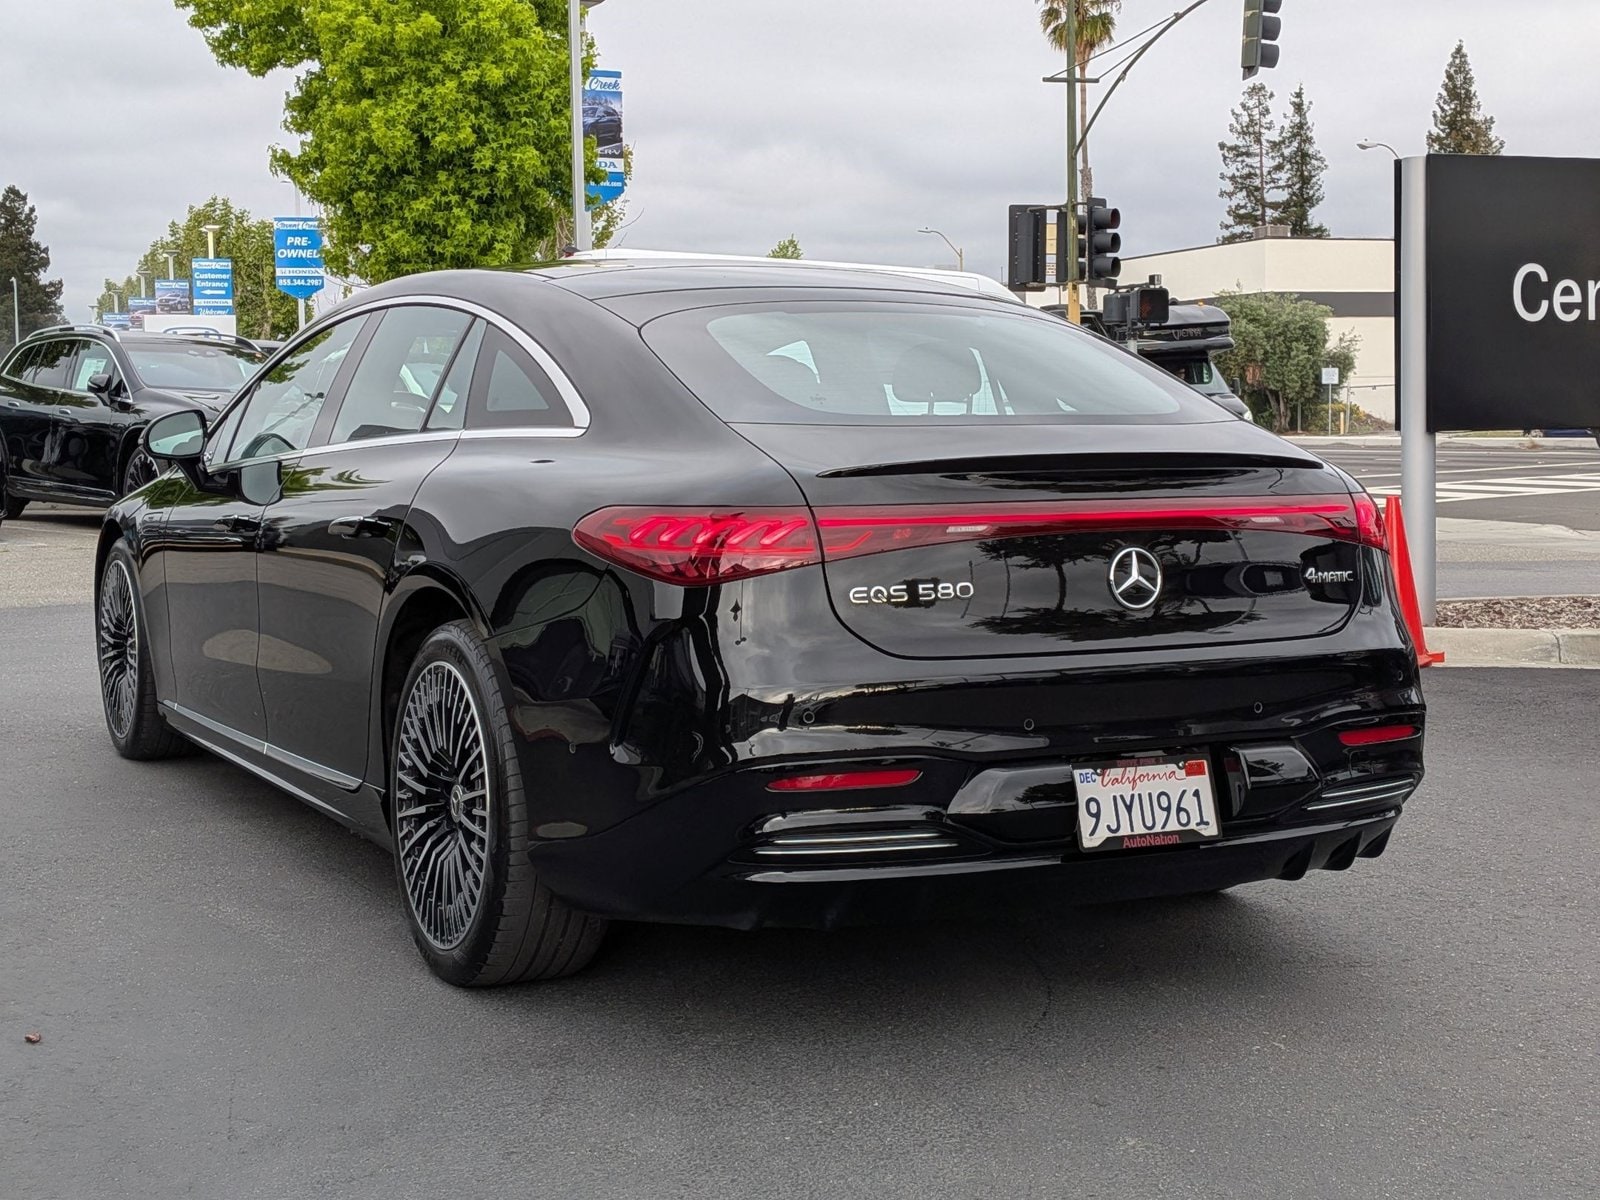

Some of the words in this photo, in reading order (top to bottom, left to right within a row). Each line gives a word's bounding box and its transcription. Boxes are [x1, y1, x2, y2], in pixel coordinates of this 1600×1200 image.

[588, 77, 620, 91] Creek
[286, 236, 312, 246] PRE-
[194, 271, 231, 280] Customer
[196, 280, 229, 288] Entrance
[1512, 262, 1600, 323] Cer
[849, 585, 909, 604] EQS
[918, 581, 974, 600] 580
[1079, 771, 1097, 784] DEC
[1100, 766, 1187, 791] California
[1084, 788, 1210, 837] 9JYU961
[1123, 833, 1180, 849] AutoNation
